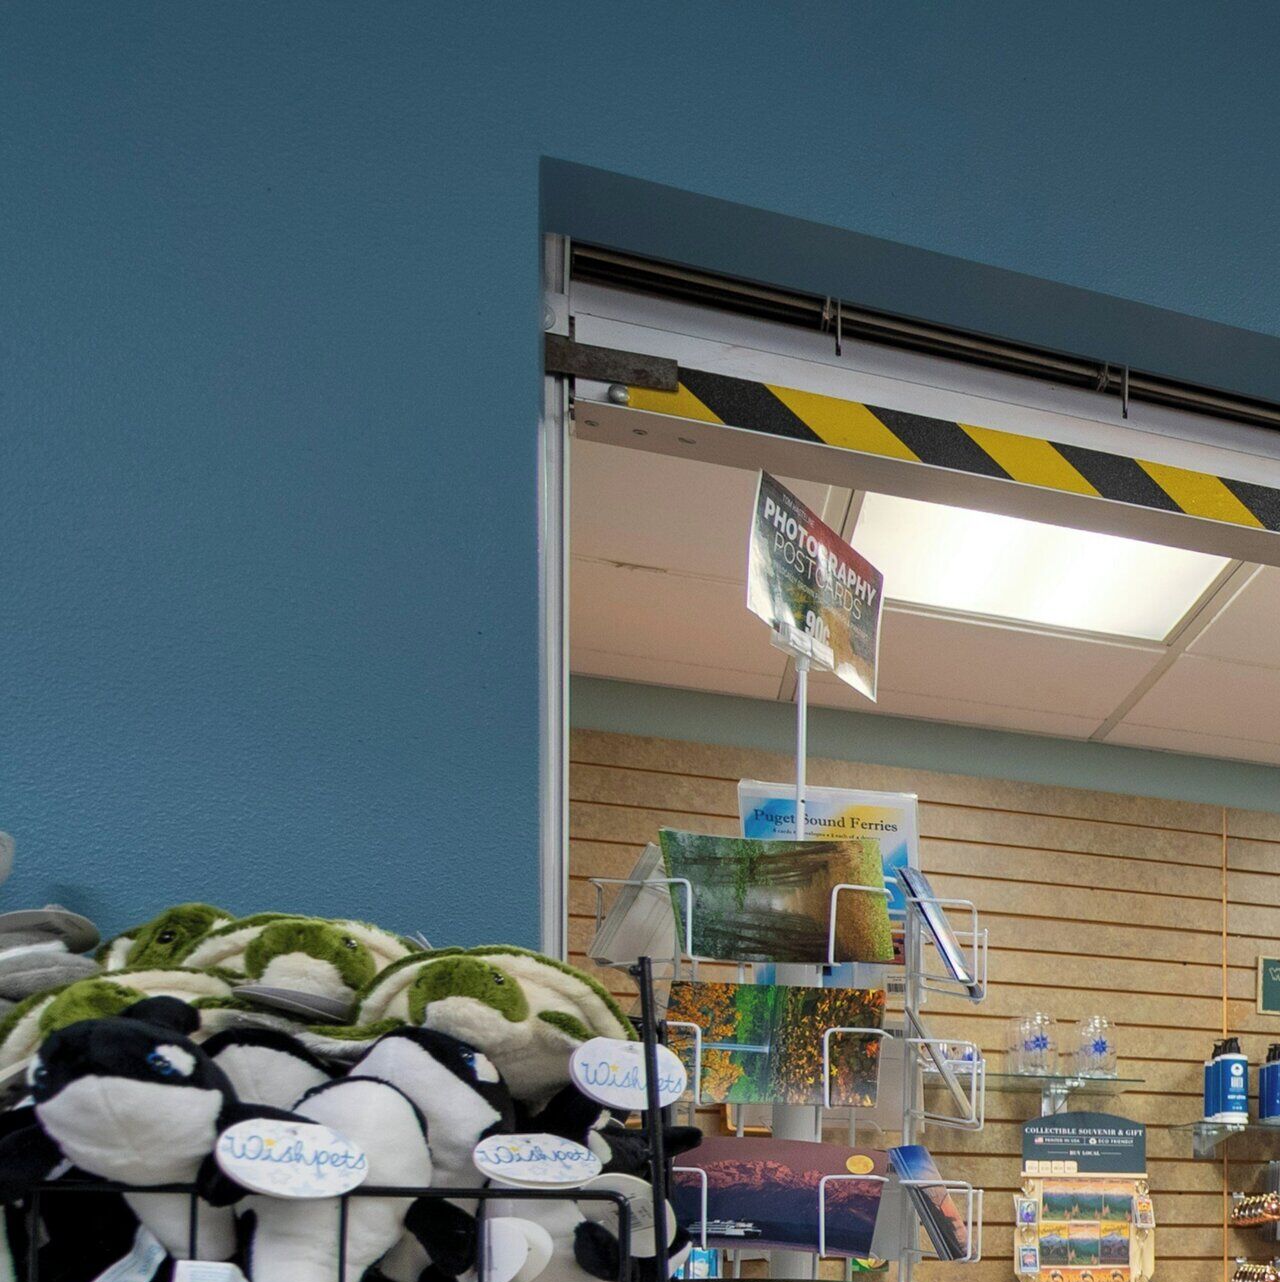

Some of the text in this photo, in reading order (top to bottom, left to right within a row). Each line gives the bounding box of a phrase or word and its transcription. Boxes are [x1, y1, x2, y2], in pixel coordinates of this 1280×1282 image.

[764, 496, 876, 606] PHOTOGRAPHY
[774, 532, 863, 620] POSTCARDS
[754, 808, 796, 827] Puget
[850, 816, 898, 833] Ferries
[581, 1060, 684, 1095] Wishets
[1024, 1126, 1076, 1135] COLLECTIBLE
[1078, 1128, 1117, 1136] SOUVENIR
[1125, 1129, 1144, 1137] GIFT
[224, 1134, 368, 1175] Wishpets
[475, 1145, 597, 1170] Wishpets
